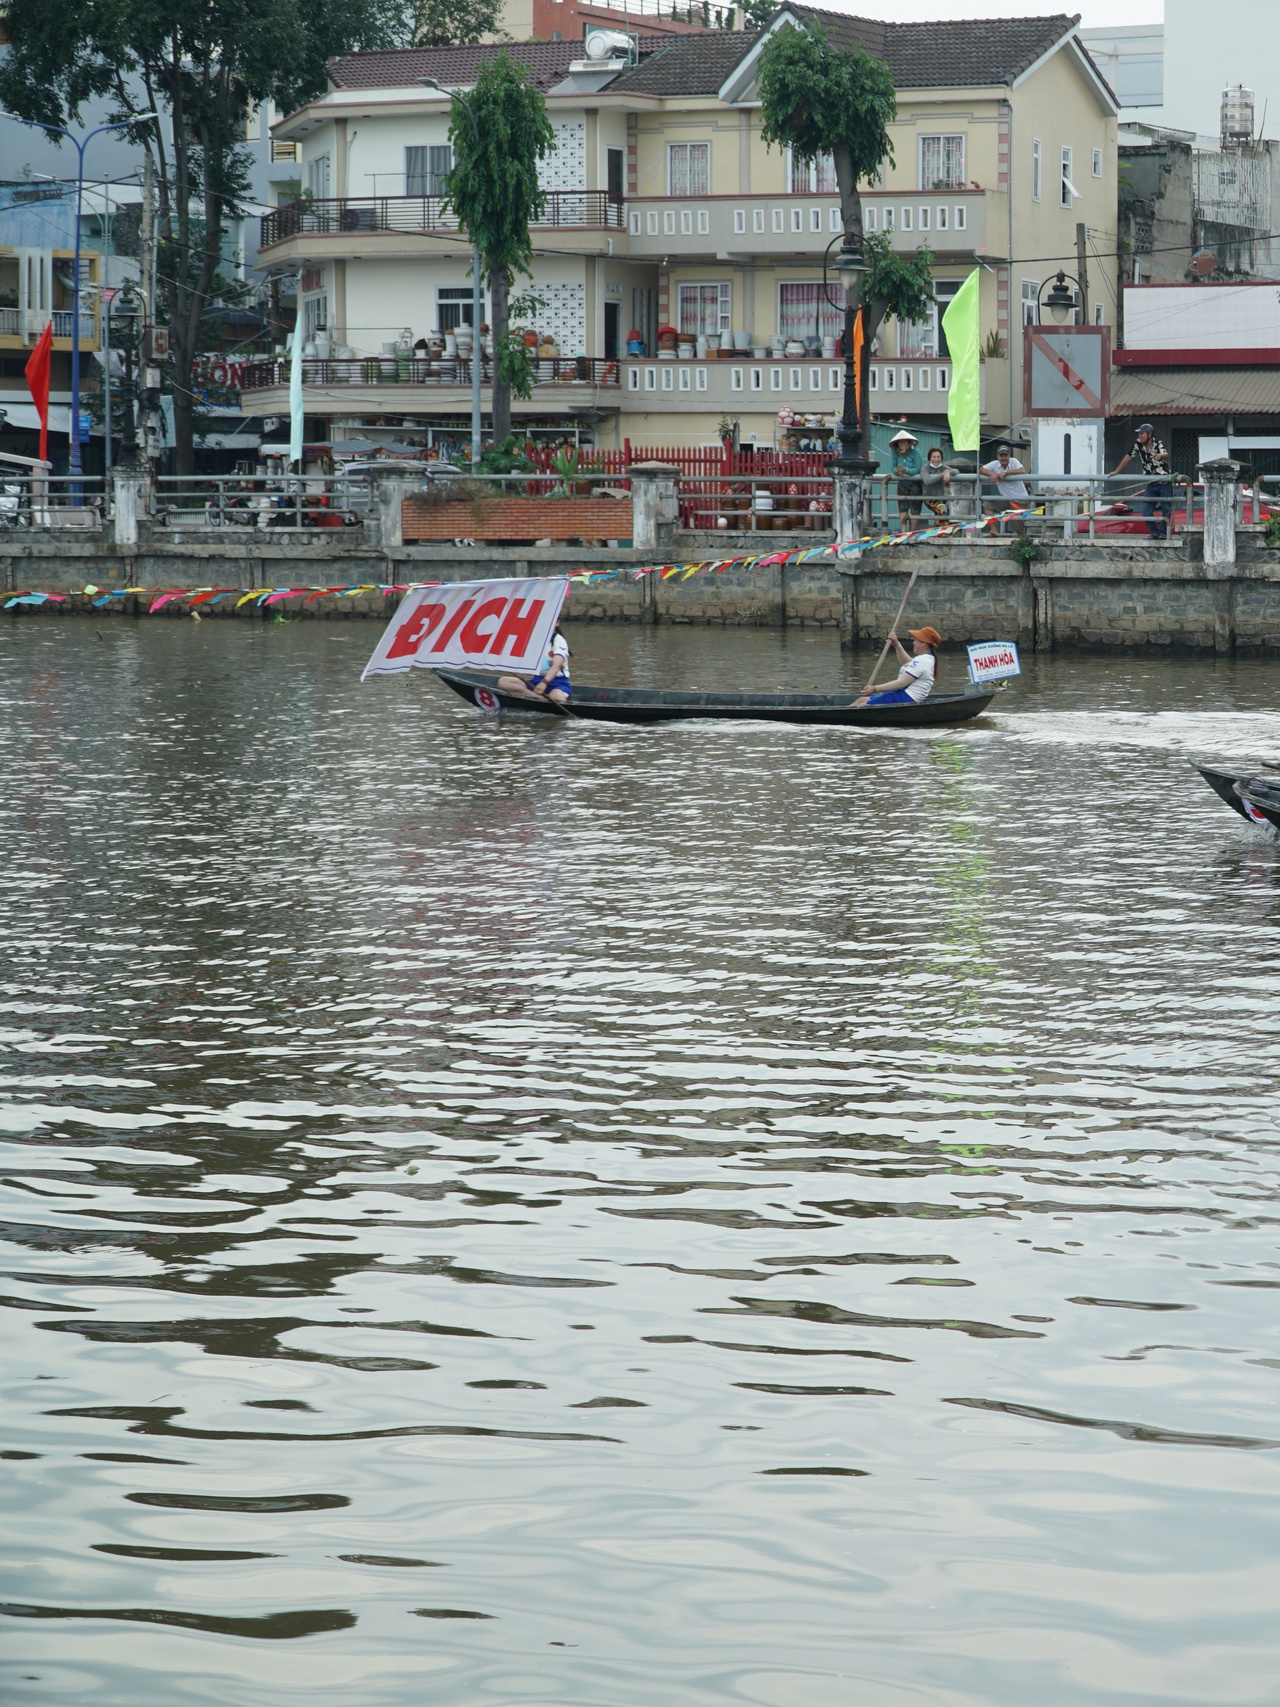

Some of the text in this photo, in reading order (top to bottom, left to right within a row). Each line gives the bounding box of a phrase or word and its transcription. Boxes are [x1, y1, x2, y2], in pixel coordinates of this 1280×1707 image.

[385, 586, 546, 659] ĐÍCH
[973, 649, 1015, 672] THẠNH HÓA
[477, 689, 494, 708] 8
